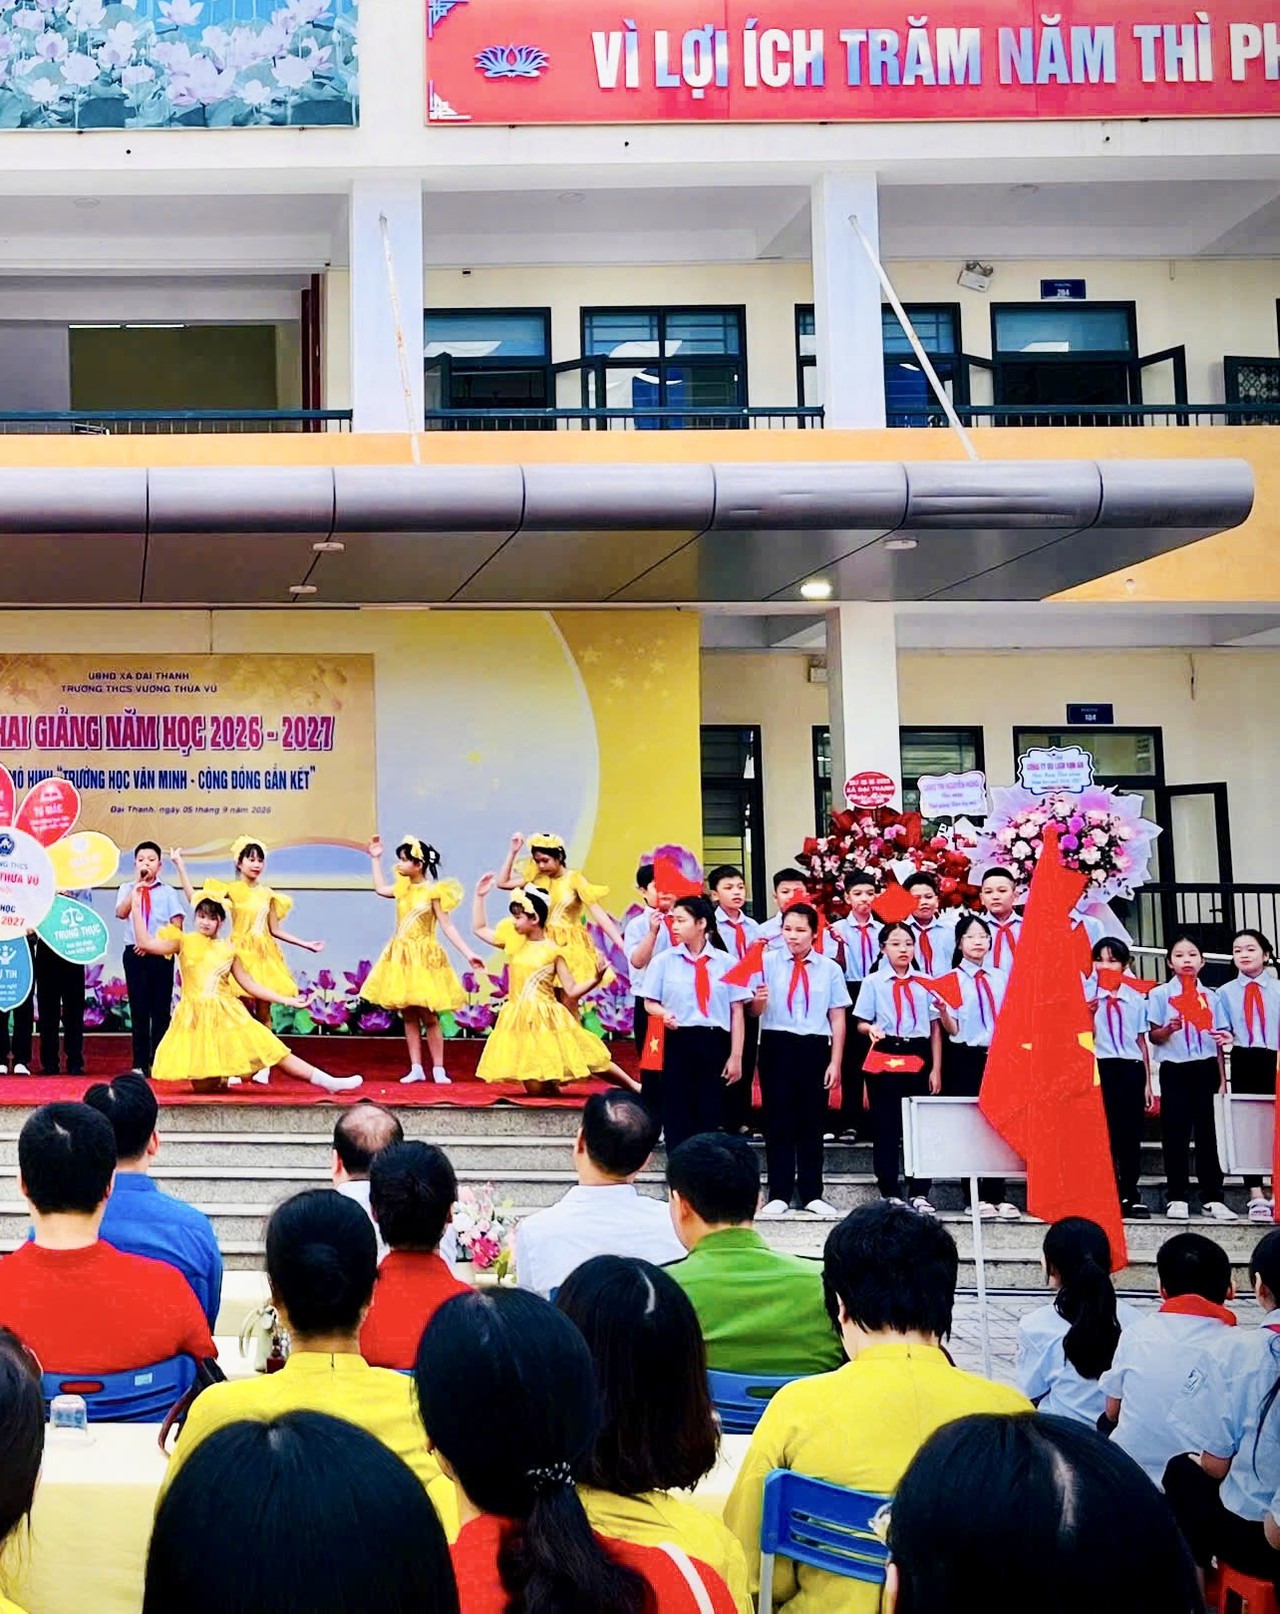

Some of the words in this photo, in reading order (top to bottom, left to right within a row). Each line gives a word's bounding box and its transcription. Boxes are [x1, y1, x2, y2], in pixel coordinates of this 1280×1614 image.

[591, 17, 640, 88] VÌ
[654, 23, 729, 99] LỢI
[744, 17, 825, 87] ÍCH
[839, 15, 982, 86] TRĂM
[998, 13, 1117, 84] NĂM
[1133, 11, 1213, 83] THÌ
[88, 672, 117, 680] UBND
[155, 672, 190, 680] THANH
[106, 685, 133, 693] THCS
[34, 707, 102, 750] GIẢNG
[105, 708, 159, 750] NĂM
[163, 715, 205, 756] HỌC
[210, 715, 263, 750] 2026
[267, 731, 278, 740] -
[282, 715, 334, 750] 2027
[108, 770, 130, 793] HỌC
[133, 766, 155, 789] VĂN
[158, 770, 187, 789] MINH
[198, 766, 228, 793] CỘNG
[1, 915, 25, 926] 2027
[5, 969, 17, 978] TIN
